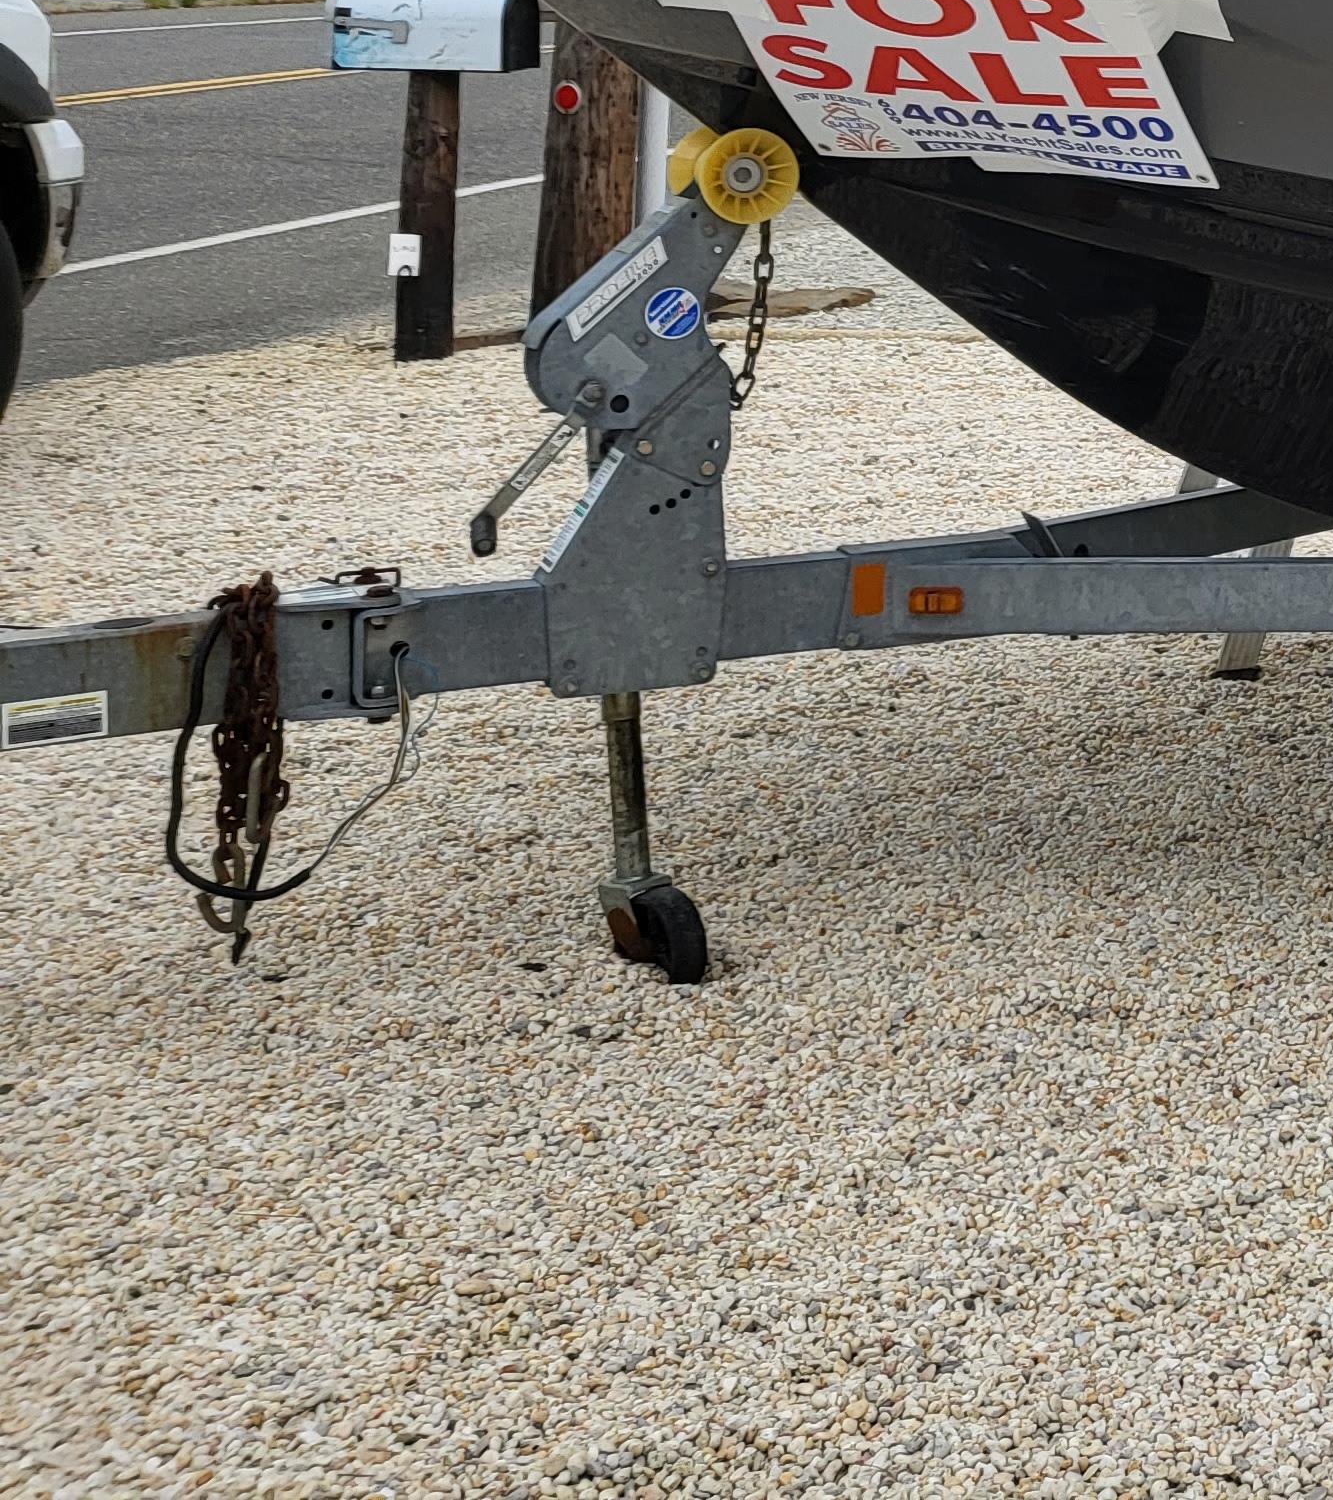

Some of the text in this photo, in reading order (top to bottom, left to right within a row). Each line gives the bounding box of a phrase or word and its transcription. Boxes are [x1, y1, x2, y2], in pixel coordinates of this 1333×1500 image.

[760, 33, 1162, 110] SALE
[793, 92, 873, 109] NEW JERSEY
[901, 103, 1175, 142] 404-4500
[900, 127, 1183, 160] www.NJYachtSales.com
[1087, 158, 1182, 177] TRADE
